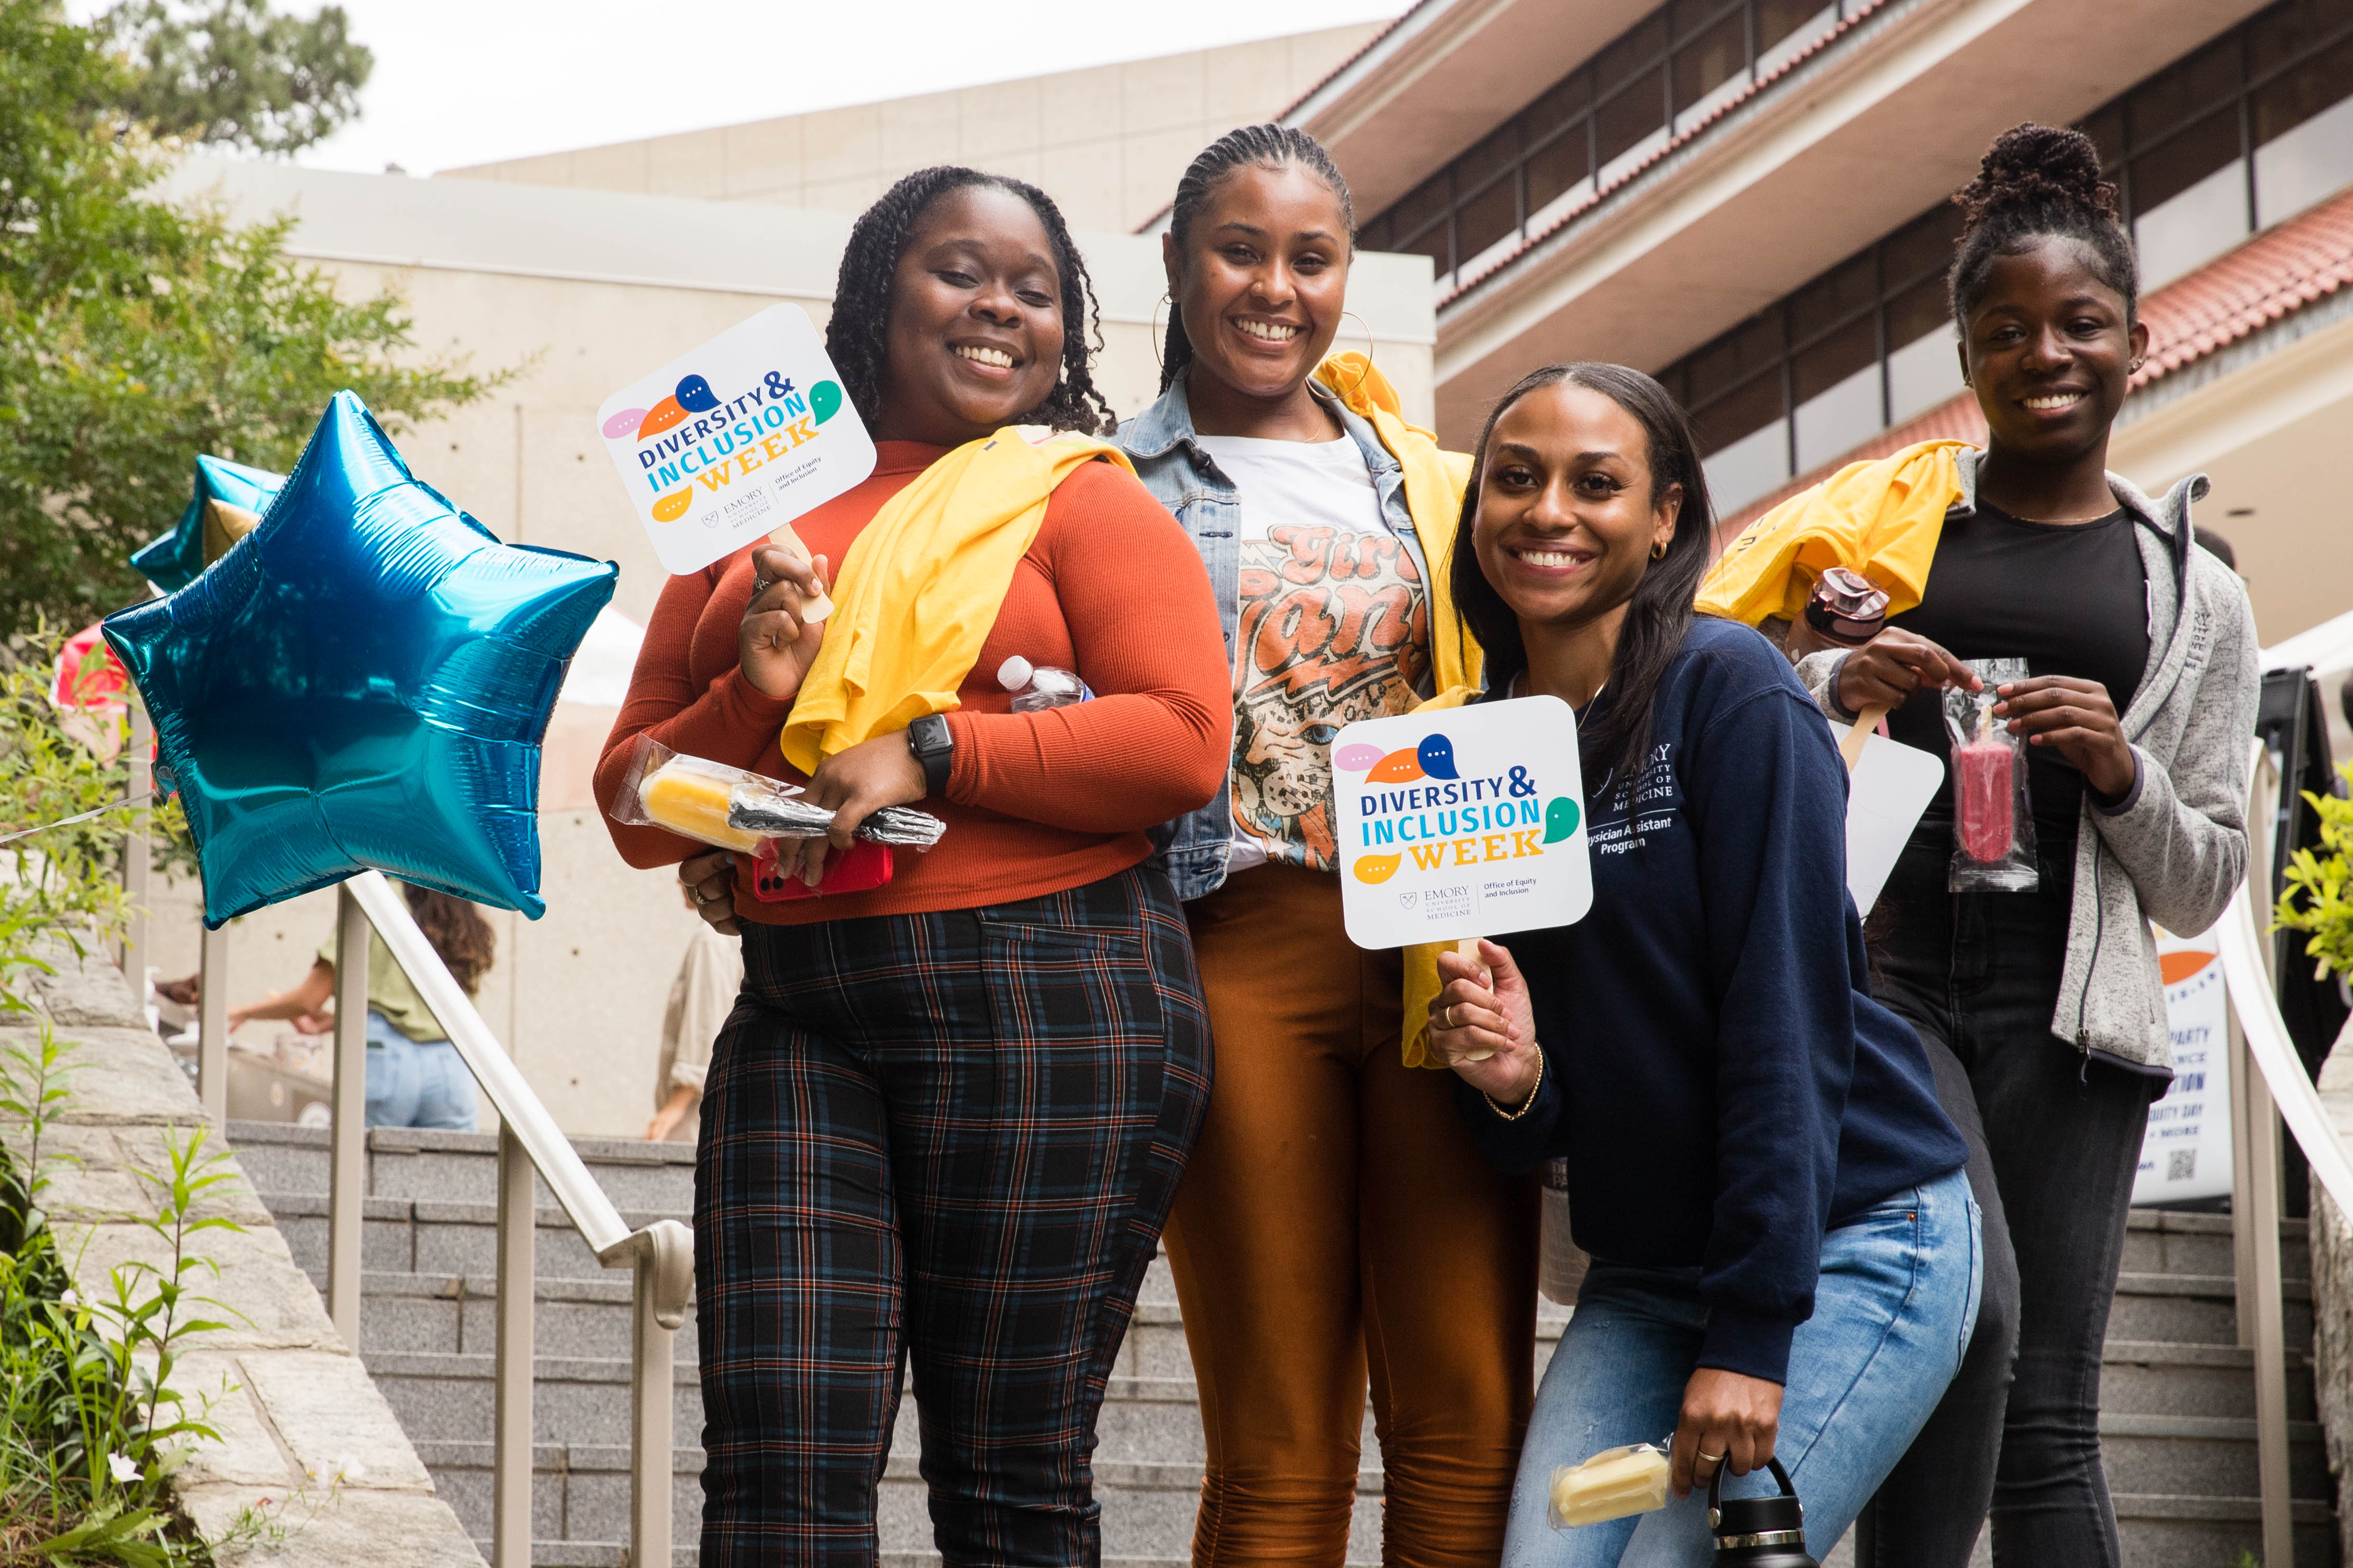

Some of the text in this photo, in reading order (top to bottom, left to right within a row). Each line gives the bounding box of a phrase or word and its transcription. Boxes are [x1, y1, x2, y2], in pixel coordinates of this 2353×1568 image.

[638, 370, 795, 469] DIVERSITY &
[646, 392, 807, 493] INCLUSION
[696, 415, 819, 492] WEEK
[775, 471, 794, 483] Office
[802, 456, 821, 469] Equity
[779, 467, 817, 490] and Inclusion
[724, 487, 762, 514] EMORY
[733, 506, 772, 529] MEDICINE
[1622, 743, 1671, 779] MORY
[1615, 775, 1671, 800] SCOOL OF
[1617, 764, 1671, 789] UNERSITY
[1360, 765, 1537, 816] DIVERSITY &
[1362, 799, 1540, 847] INCLUSION
[1408, 829, 1544, 871] WEEK
[1587, 828, 1622, 847] ysician
[1425, 885, 1469, 900] EMORY
[1499, 887, 1529, 896] Inclusion
[1516, 878, 1537, 886] Equity
[1426, 897, 1470, 907] UNIVERSITY
[1427, 909, 1471, 920] MEDICINE
